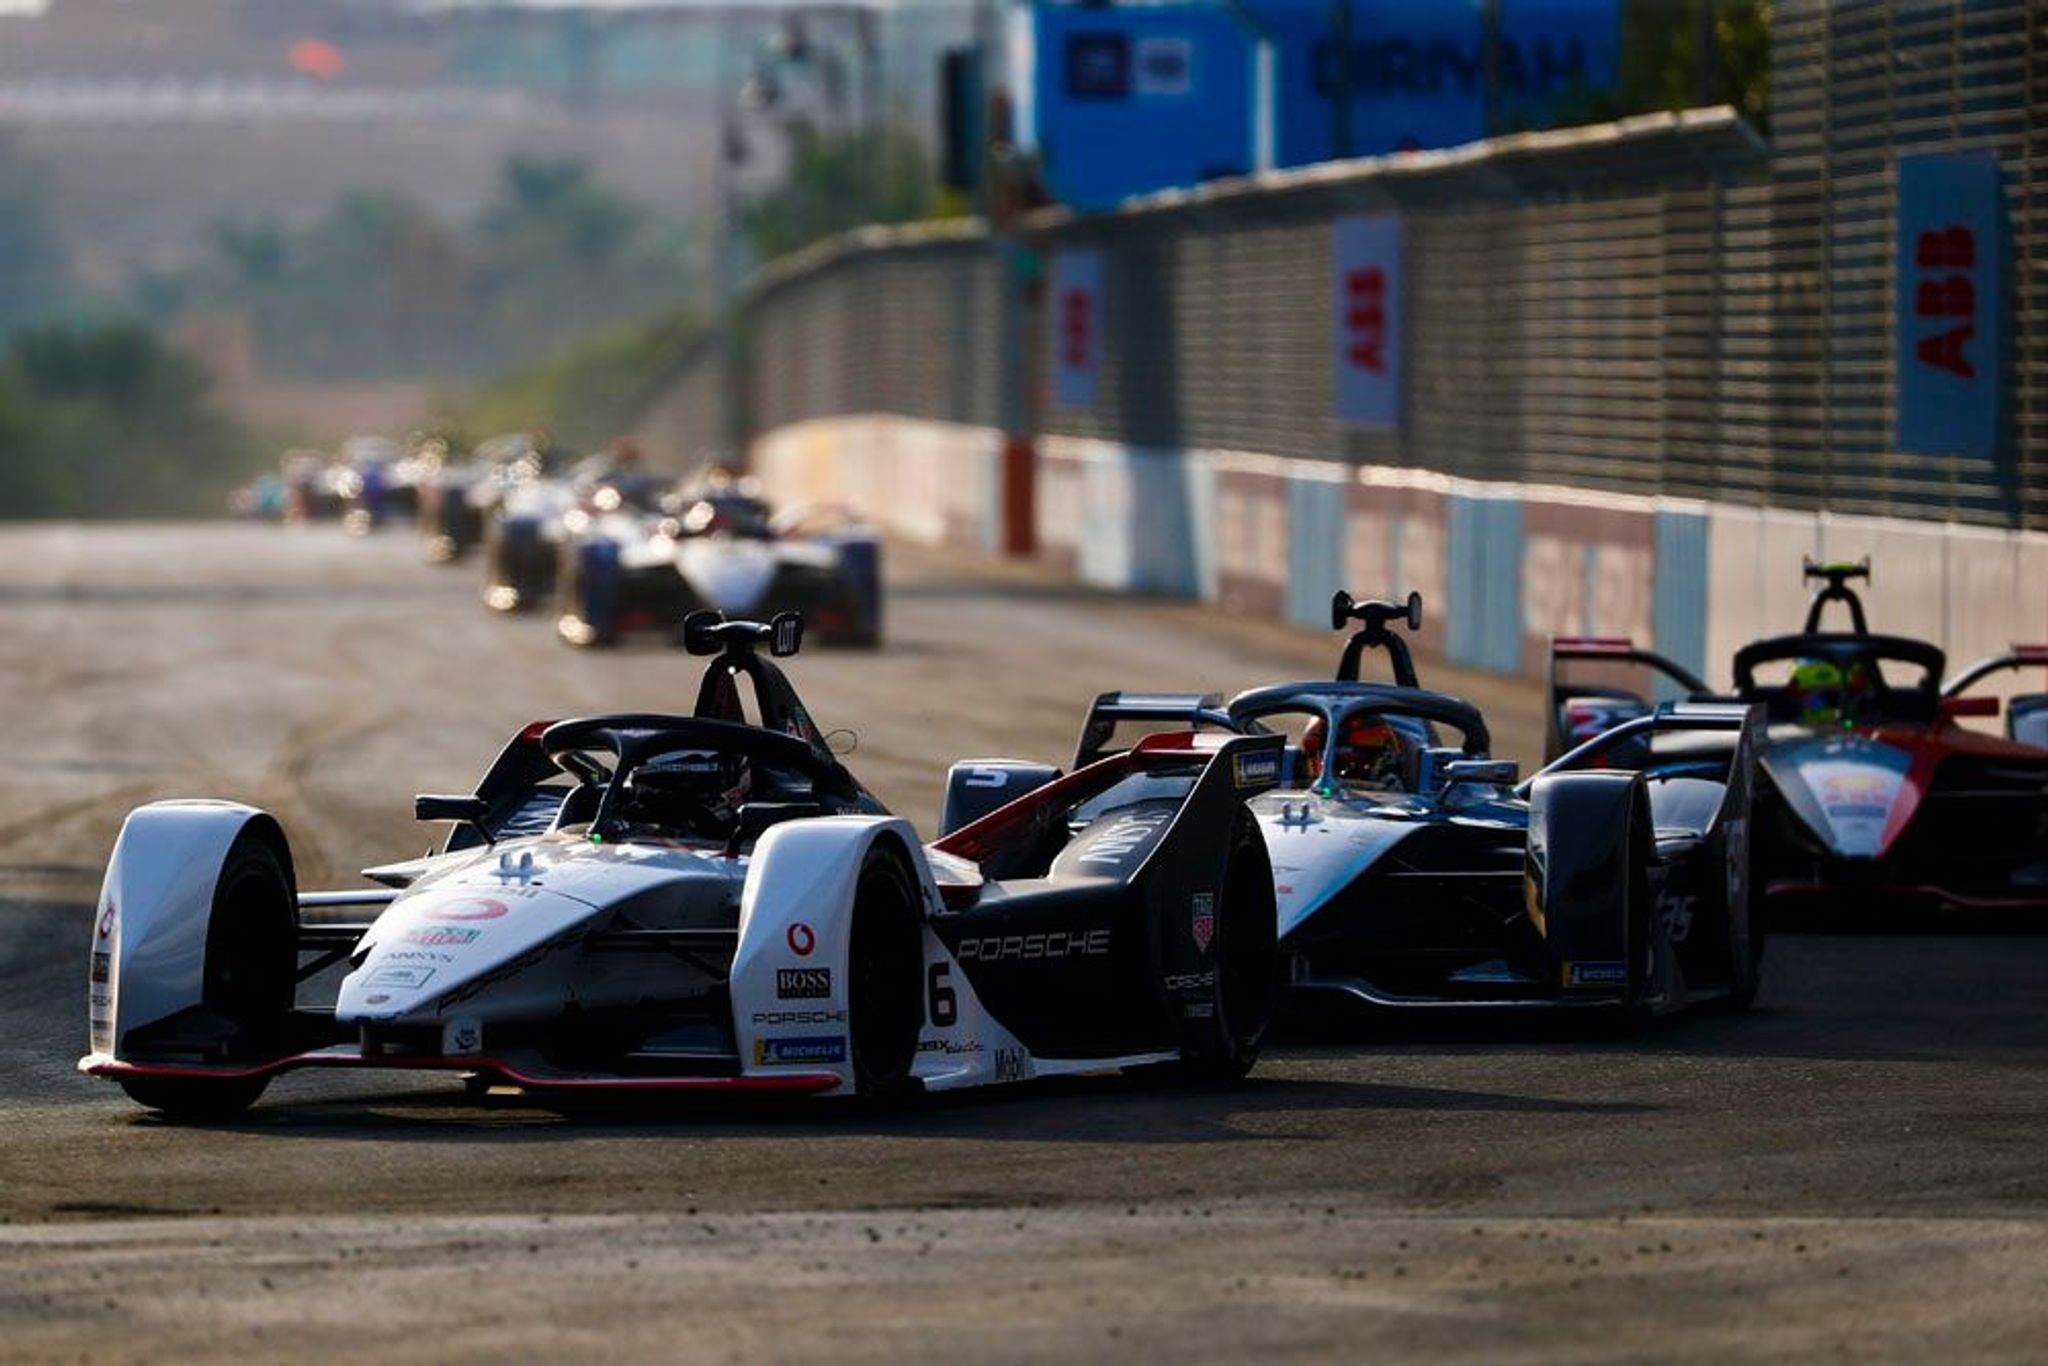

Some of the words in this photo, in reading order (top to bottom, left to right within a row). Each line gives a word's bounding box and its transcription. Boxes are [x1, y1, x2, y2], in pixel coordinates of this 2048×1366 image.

[1918, 223, 1974, 378] ABB
[957, 930, 1111, 961] PORSCHE
[779, 971, 829, 989] BOSS
[929, 962, 956, 1026] 6
[752, 1009, 848, 1025] PORSCHE
